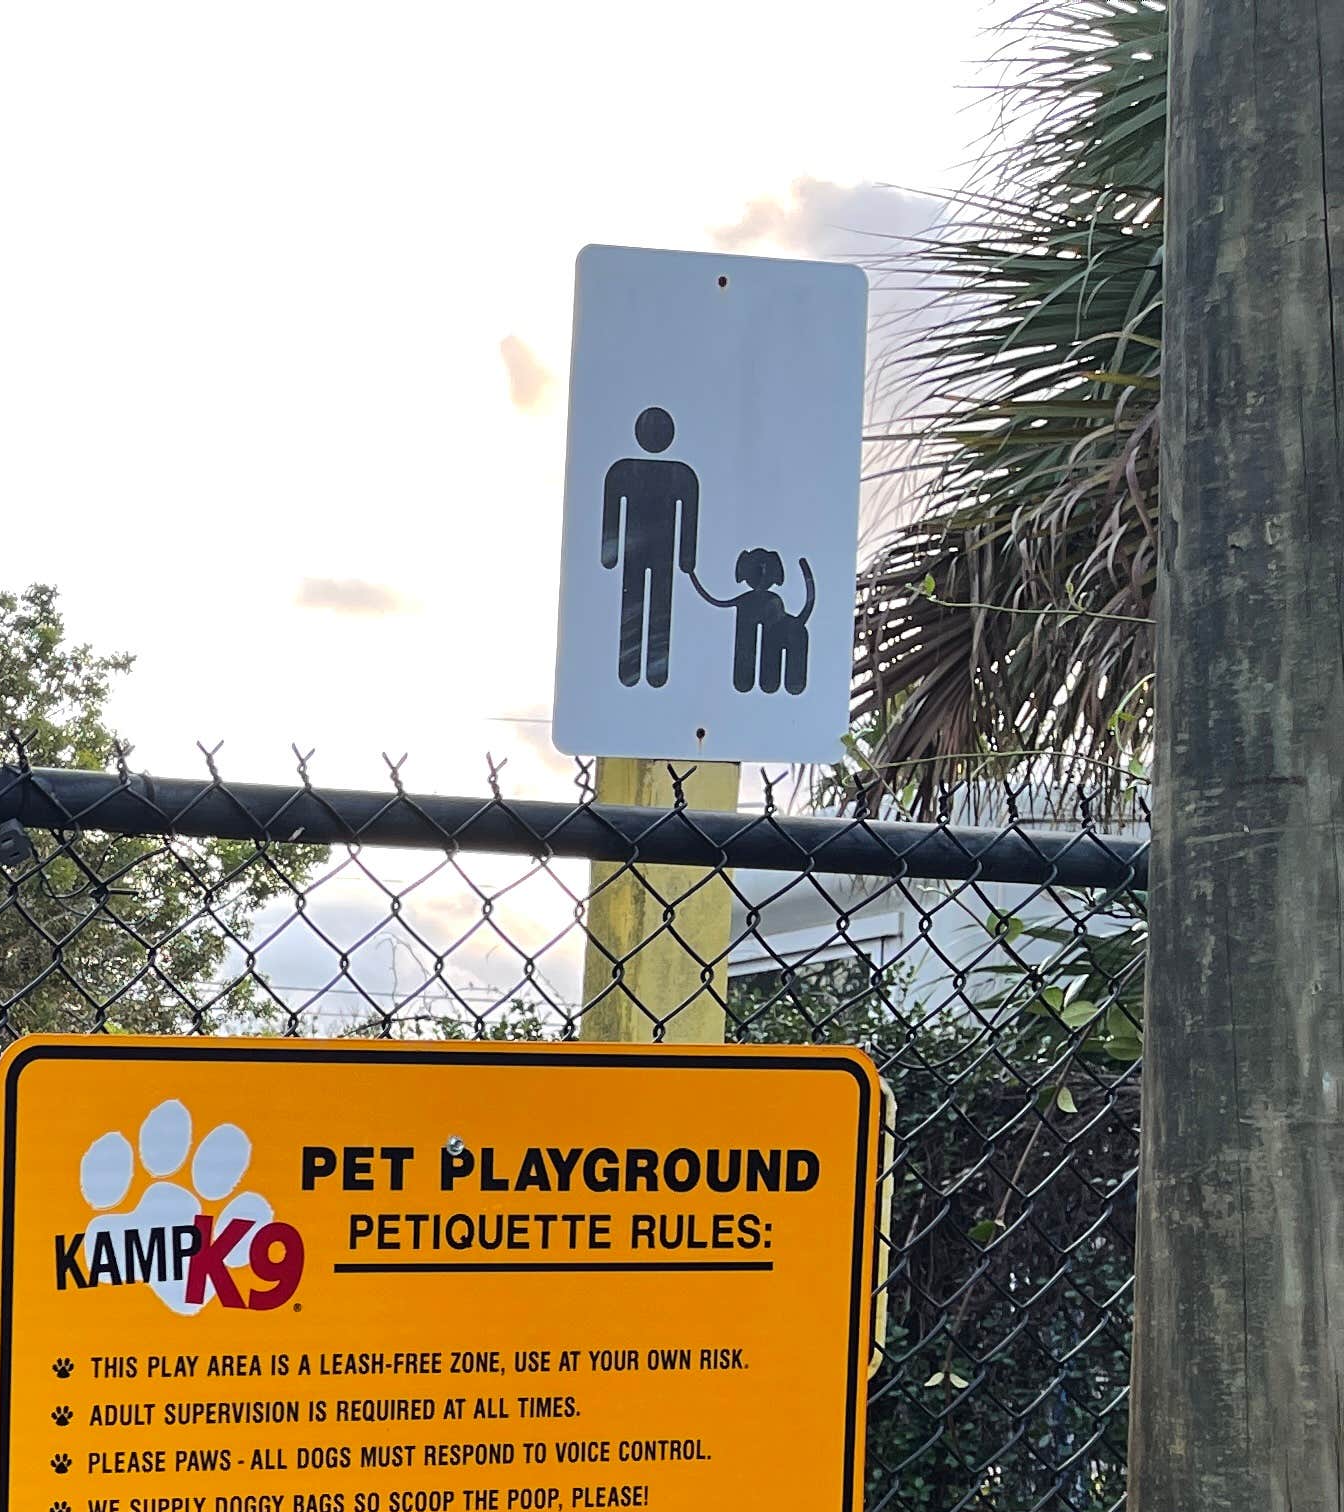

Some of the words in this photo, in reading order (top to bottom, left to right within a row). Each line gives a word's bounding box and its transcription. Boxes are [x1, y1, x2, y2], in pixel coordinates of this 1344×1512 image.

[301, 1146, 415, 1192] PET
[440, 1147, 820, 1193] PLAYGROUND
[349, 1213, 612, 1251] PETIQUETTE
[631, 1213, 773, 1250] RULES:
[90, 1356, 138, 1379] THIS
[147, 1355, 199, 1378] PLAY
[206, 1354, 262, 1377] AREA
[271, 1353, 290, 1376] IS
[297, 1354, 311, 1376] A
[320, 1352, 442, 1376] LEASH-FREE
[449, 1351, 505, 1376] ZONE,
[514, 1350, 551, 1373] USE
[558, 1350, 581, 1372] AT
[588, 1349, 639, 1372] YOUR
[647, 1349, 692, 1371] OWN
[699, 1348, 749, 1370] RISK.
[89, 1403, 156, 1426] ADULT
[164, 1400, 300, 1426] SUPERVISION
[308, 1400, 327, 1423] IS
[336, 1398, 436, 1422] REQUIRED
[443, 1398, 467, 1420] AT
[473, 1397, 509, 1420] ALL
[517, 1396, 581, 1418] TIMES.
[88, 1450, 166, 1474] PLEASE
[175, 1449, 231, 1472] PAWS
[250, 1448, 288, 1470] ALL
[297, 1446, 351, 1469] DOGS
[360, 1445, 417, 1468] MUST
[423, 1443, 515, 1466] RESPOND
[522, 1442, 547, 1464] TO
[555, 1441, 611, 1464] VOICE
[618, 1439, 712, 1462] CONTROL.
[462, 1489, 499, 1511] THE
[507, 1487, 563, 1511] POOP,
[572, 1485, 649, 1508] PLEASE!
